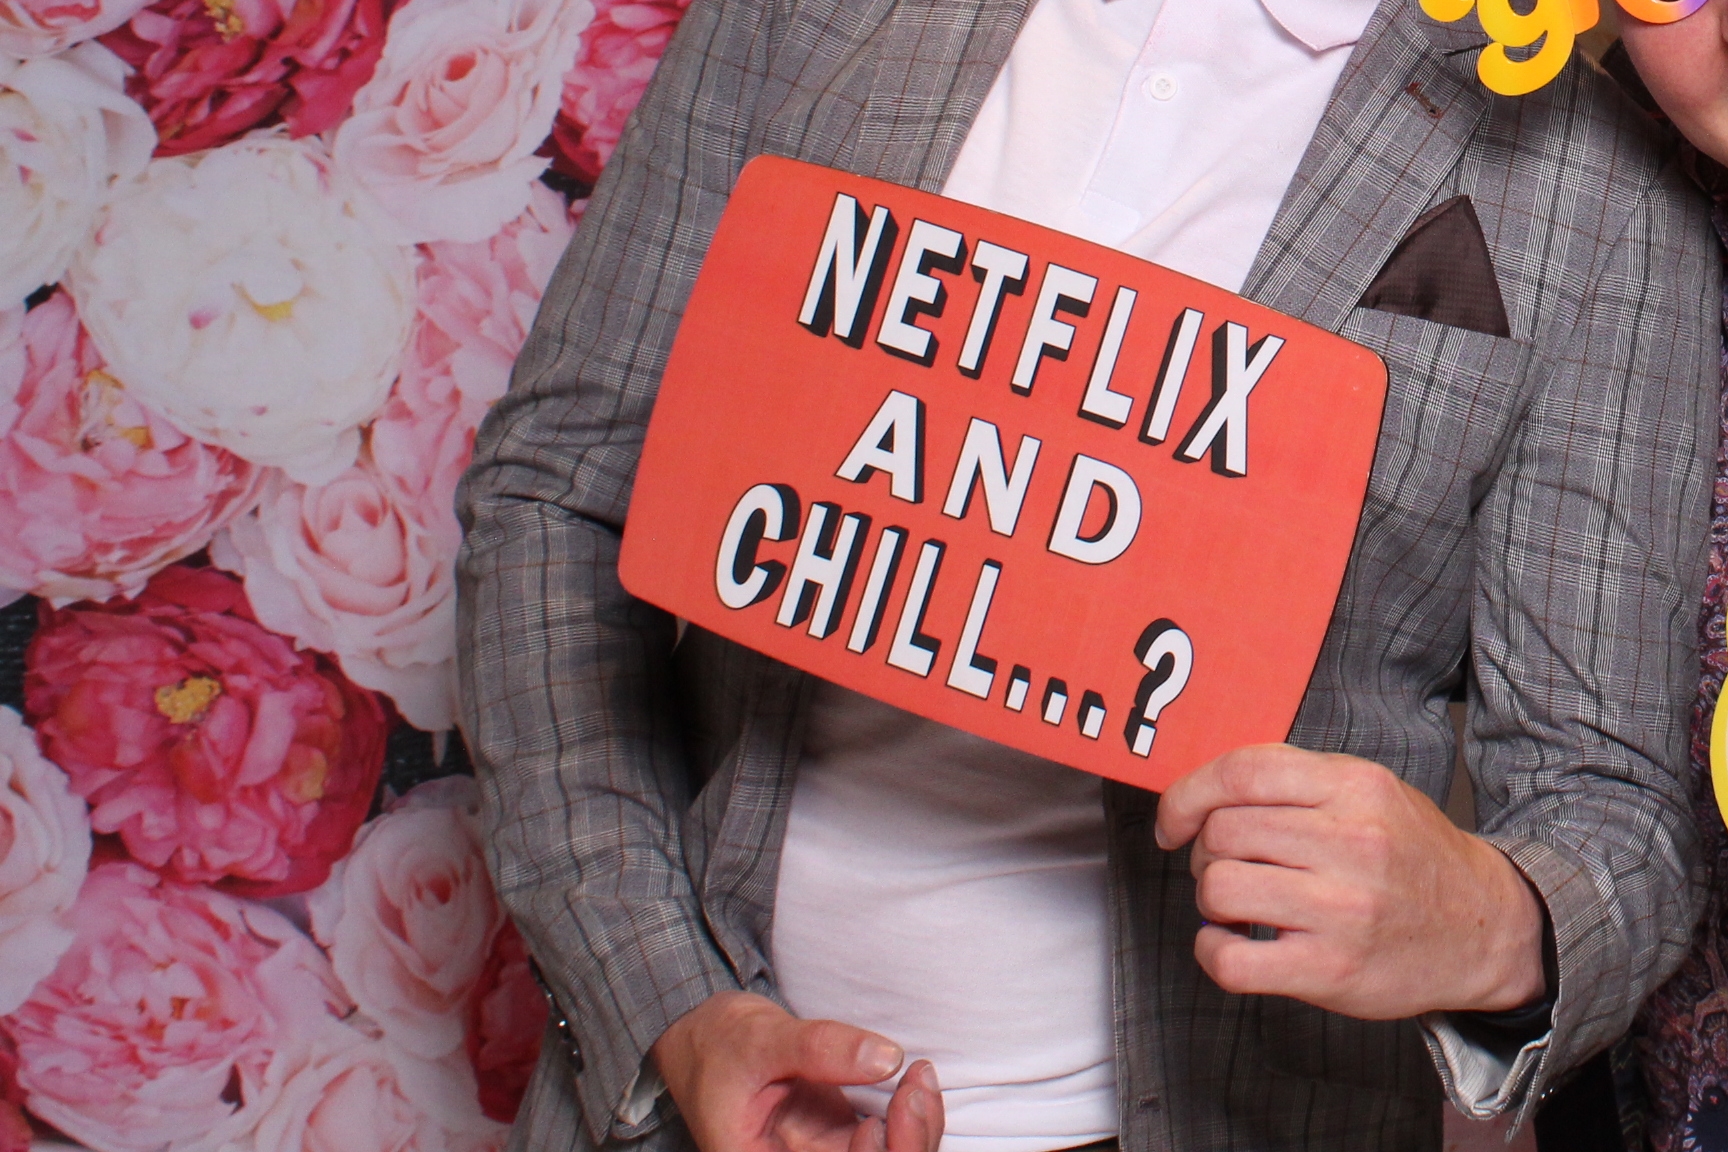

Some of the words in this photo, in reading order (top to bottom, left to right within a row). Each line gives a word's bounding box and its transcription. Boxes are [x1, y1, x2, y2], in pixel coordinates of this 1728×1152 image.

[798, 192, 1285, 476] NETFLIX
[834, 390, 1142, 564] AND
[715, 482, 1194, 757] CHILL...?
